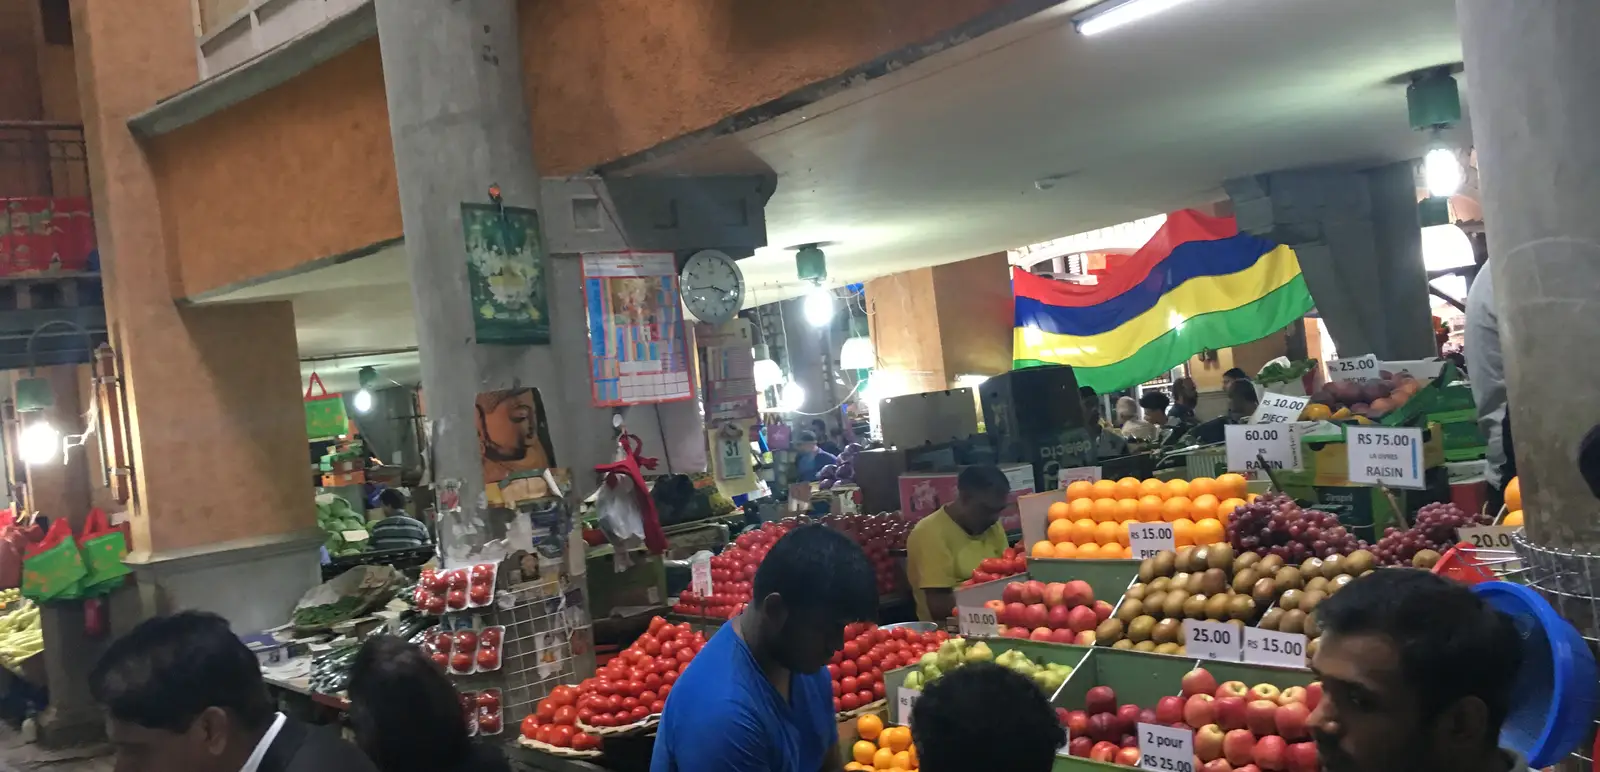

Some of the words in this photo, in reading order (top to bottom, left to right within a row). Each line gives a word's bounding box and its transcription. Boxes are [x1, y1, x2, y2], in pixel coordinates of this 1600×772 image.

[1340, 359, 1374, 371] 25.00
[1273, 398, 1304, 411] 10.00
[1245, 430, 1278, 441] 60.00
[1358, 433, 1372, 445] RS
[1375, 434, 1409, 446] 75.00
[726, 440, 739, 457] 31
[1246, 460, 1283, 470] RASIN
[1366, 466, 1403, 478] RAISIN
[1131, 531, 1140, 539] RS
[1142, 528, 1172, 540] 15.00
[1193, 628, 1230, 644] 25.00
[1248, 640, 1258, 649] RS
[1262, 637, 1302, 656] 15.00
[1147, 732, 1154, 744] 2
[1157, 736, 1184, 749] pour
[1143, 754, 1158, 767] RS
